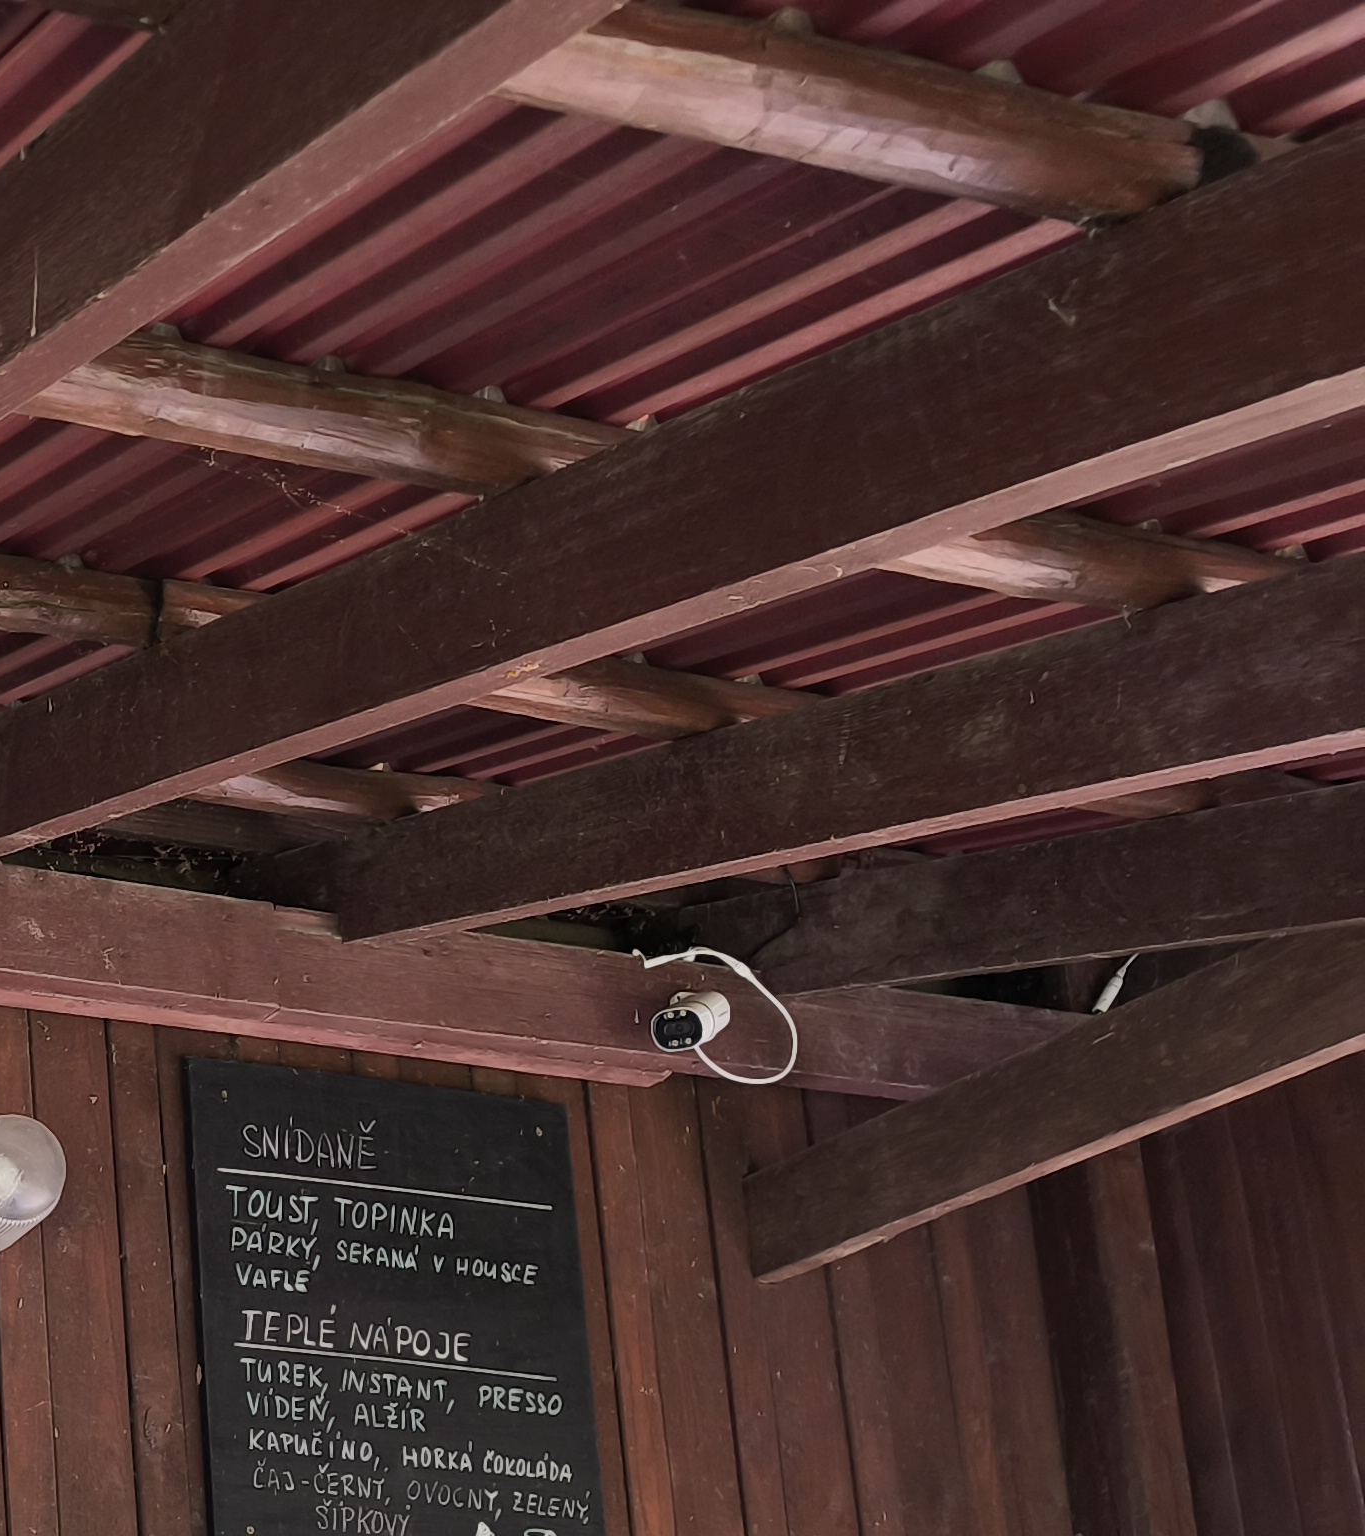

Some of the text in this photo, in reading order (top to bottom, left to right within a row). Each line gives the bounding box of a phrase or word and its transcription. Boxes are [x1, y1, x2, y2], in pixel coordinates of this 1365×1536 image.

[242, 1115, 377, 1170] SNÍDANĚ
[226, 1184, 455, 1240] TOUST, TOPINKA
[236, 1263, 309, 1293] VAFLE
[336, 1240, 419, 1271] SEKANÁ
[456, 1258, 539, 1286] HOUSCE
[242, 1304, 472, 1362] TEPLÉ NÁPOJE
[240, 1357, 563, 1416] TUREK, INSTANT, PRESSO
[354, 1403, 426, 1432] ALŽÍR
[402, 1440, 474, 1471] HORKÁ
[483, 1449, 572, 1483] ČOKOLÁDA
